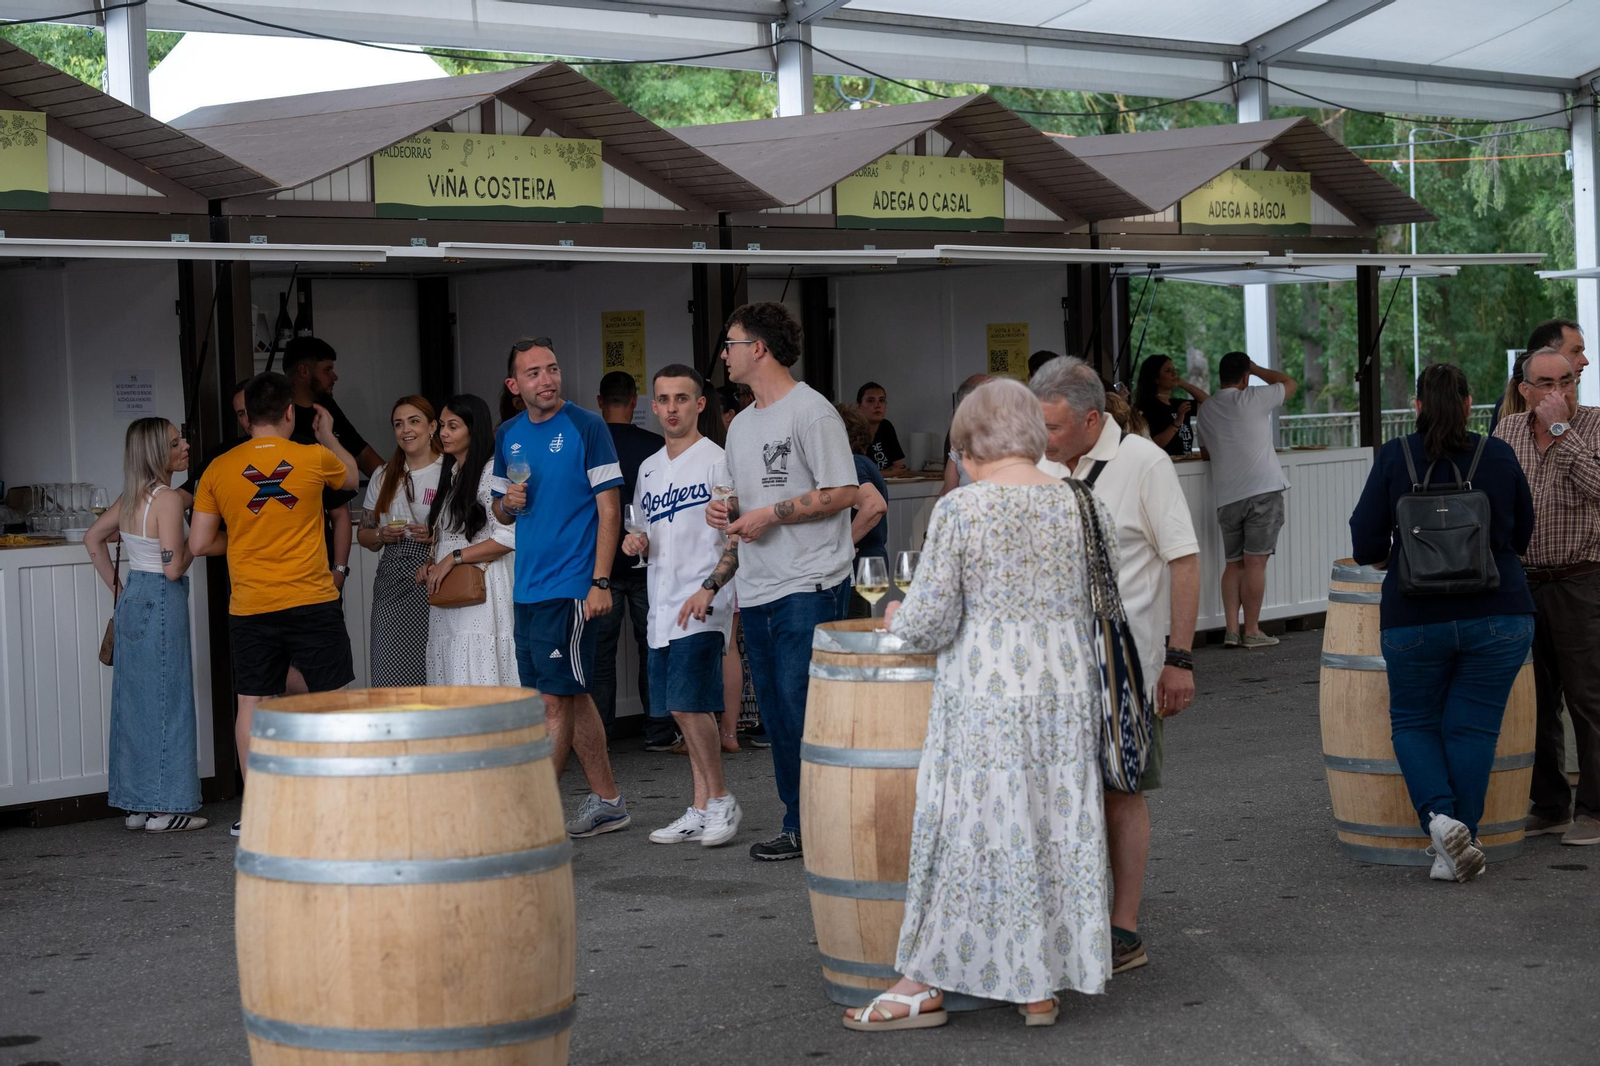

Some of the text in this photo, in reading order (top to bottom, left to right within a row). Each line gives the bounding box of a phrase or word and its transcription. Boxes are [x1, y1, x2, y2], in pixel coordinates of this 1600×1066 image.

[428, 168, 556, 200] VIÑA COSTEIRA
[872, 190, 972, 212] ADEGA O CASAL
[1208, 196, 1286, 219] ADEGA A BÁGOA
[641, 482, 712, 524] Dodgers
